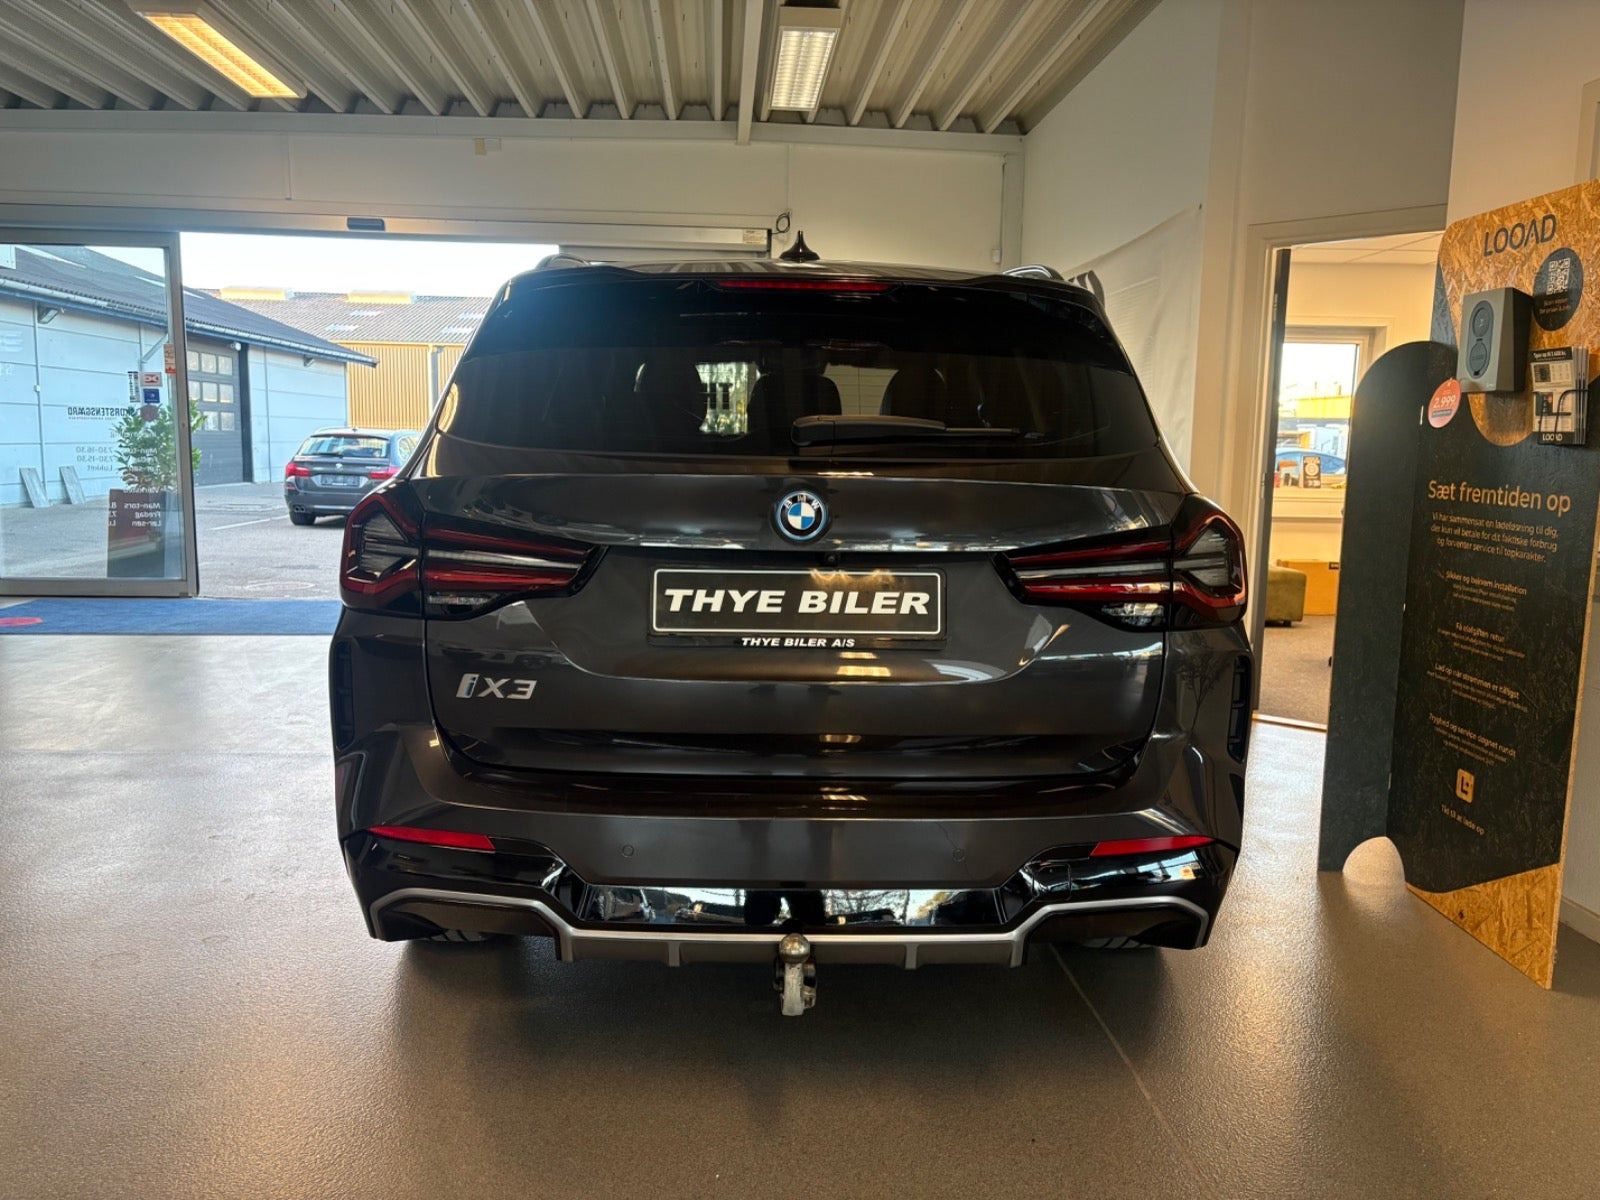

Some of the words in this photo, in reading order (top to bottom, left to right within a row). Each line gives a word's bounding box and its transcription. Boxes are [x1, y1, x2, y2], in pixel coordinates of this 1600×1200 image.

[1428, 480, 1456, 500] Sæt
[1460, 481, 1541, 510] fremtiden
[1547, 494, 1571, 517] op
[664, 589, 786, 613] THYE
[798, 591, 930, 615] BILER
[741, 637, 780, 647] THYE
[783, 637, 827, 648] BILER
[831, 638, 855, 648] A/S
[456, 673, 537, 700] iX3
